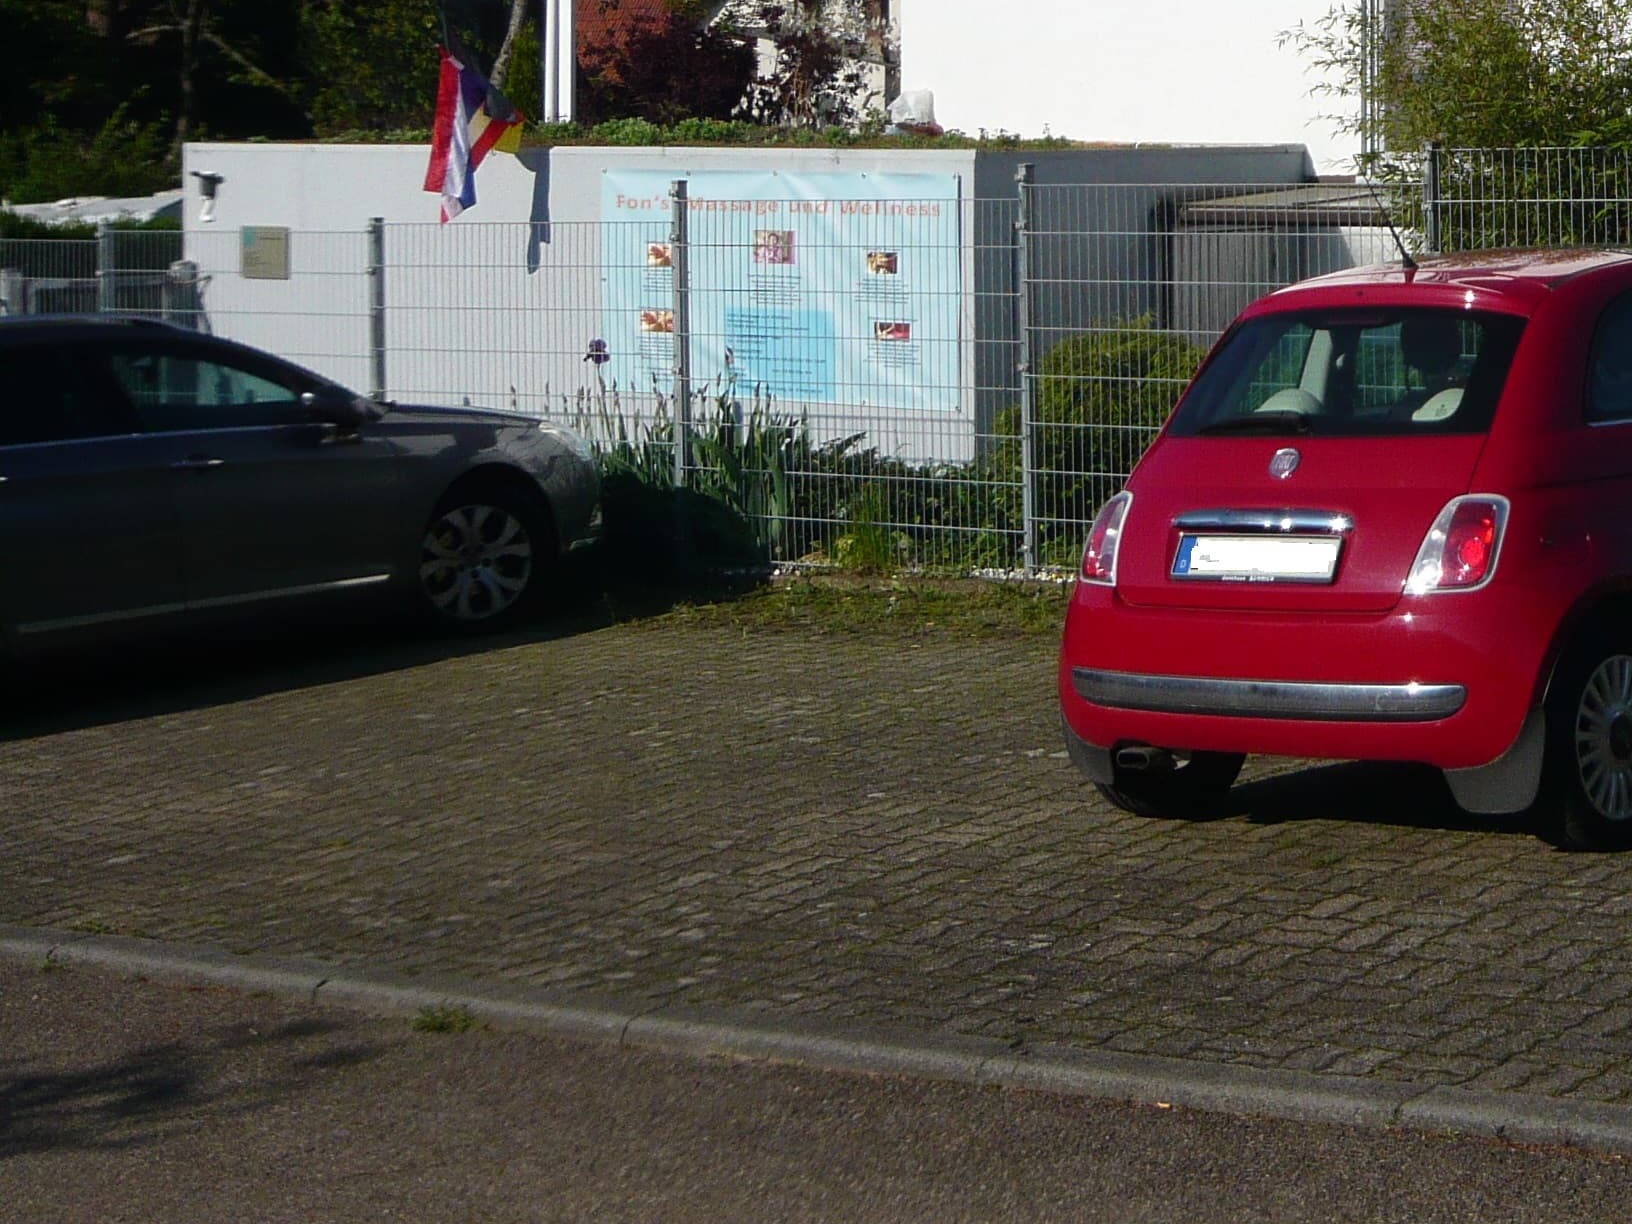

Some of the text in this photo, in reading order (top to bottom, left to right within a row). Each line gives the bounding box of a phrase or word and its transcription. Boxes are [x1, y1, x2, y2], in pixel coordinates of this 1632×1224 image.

[616, 195, 940, 216] Fon's Massage und Wellness
